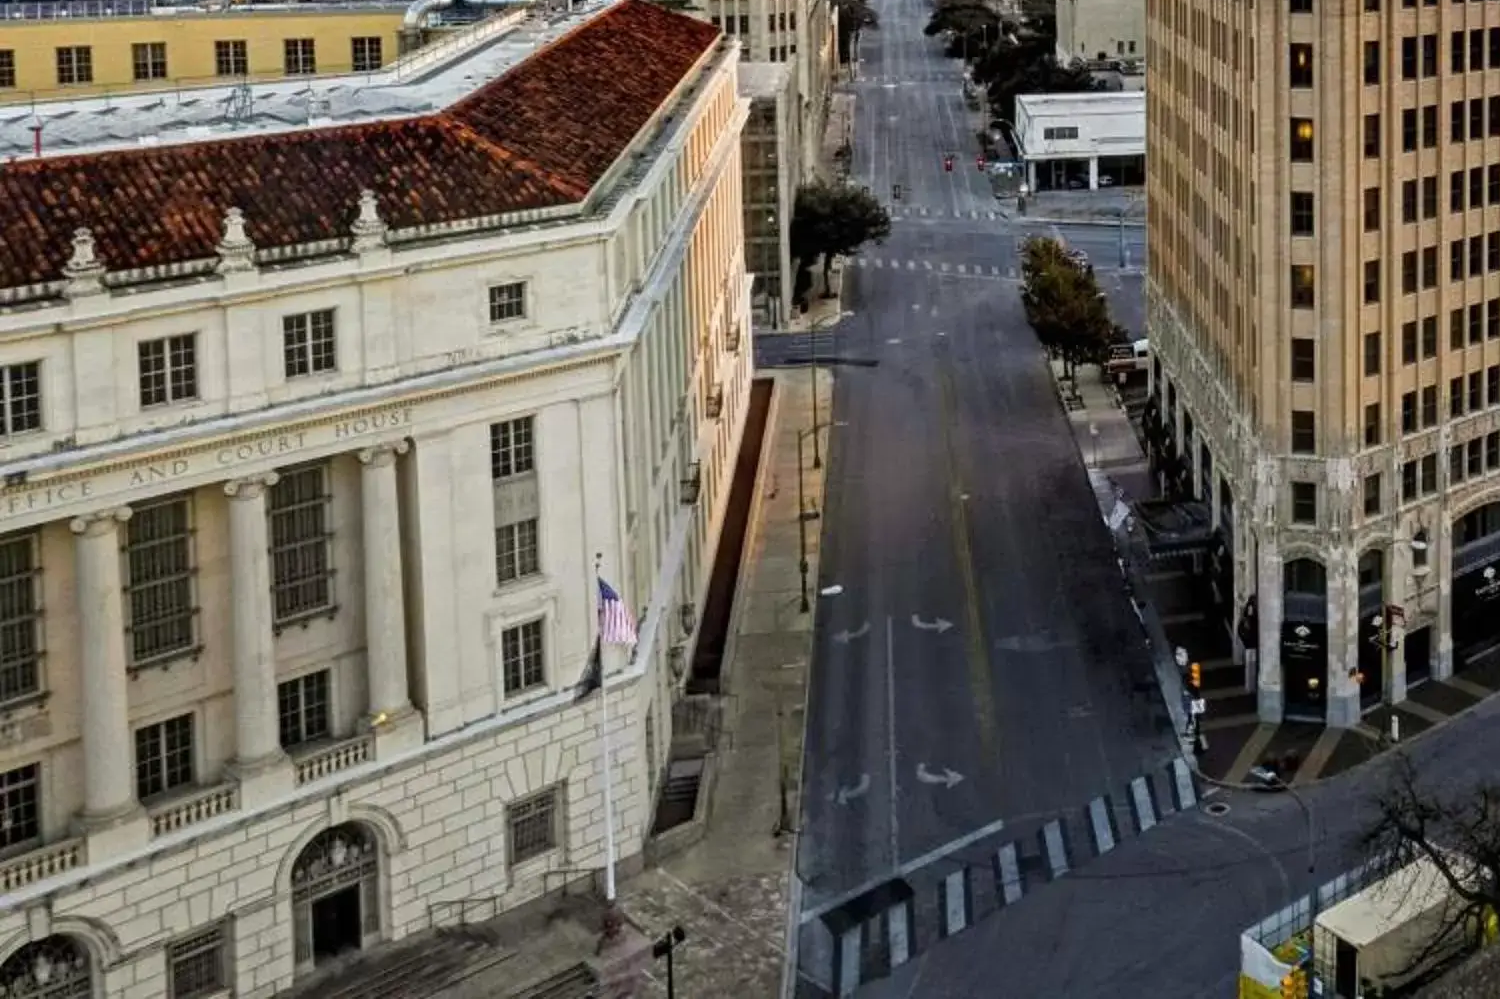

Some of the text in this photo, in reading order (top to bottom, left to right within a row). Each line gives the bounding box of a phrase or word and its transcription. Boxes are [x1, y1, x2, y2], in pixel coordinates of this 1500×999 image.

[0, 408, 413, 513] FFICE AND COURT HOUSE
